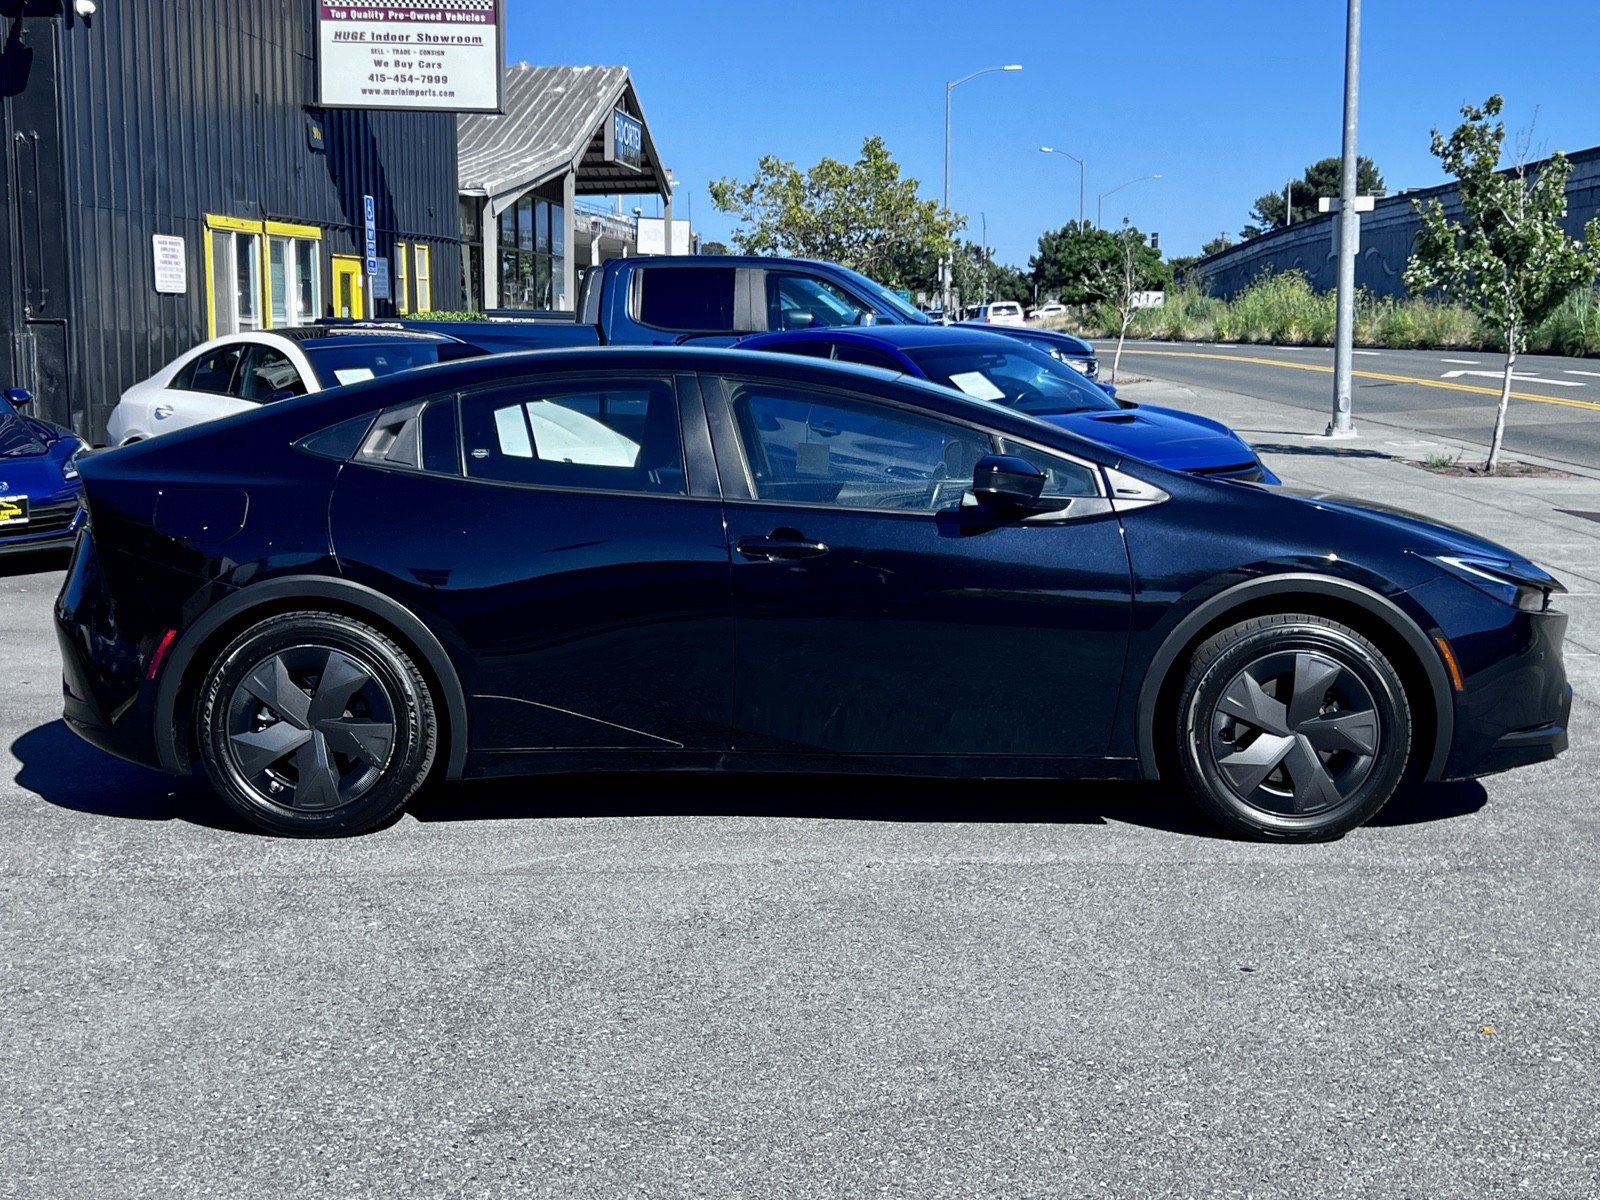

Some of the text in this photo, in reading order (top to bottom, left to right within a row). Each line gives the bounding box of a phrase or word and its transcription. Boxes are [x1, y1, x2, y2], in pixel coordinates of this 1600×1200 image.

[330, 9, 486, 22] Top Quality Pre-Owned Vehicles
[334, 30, 482, 44] HUGE Indoor Showroom
[373, 59, 442, 69] We Buy Cars
[368, 73, 448, 84] 415-454-7999
[361, 87, 455, 97] www.marinimports.com
